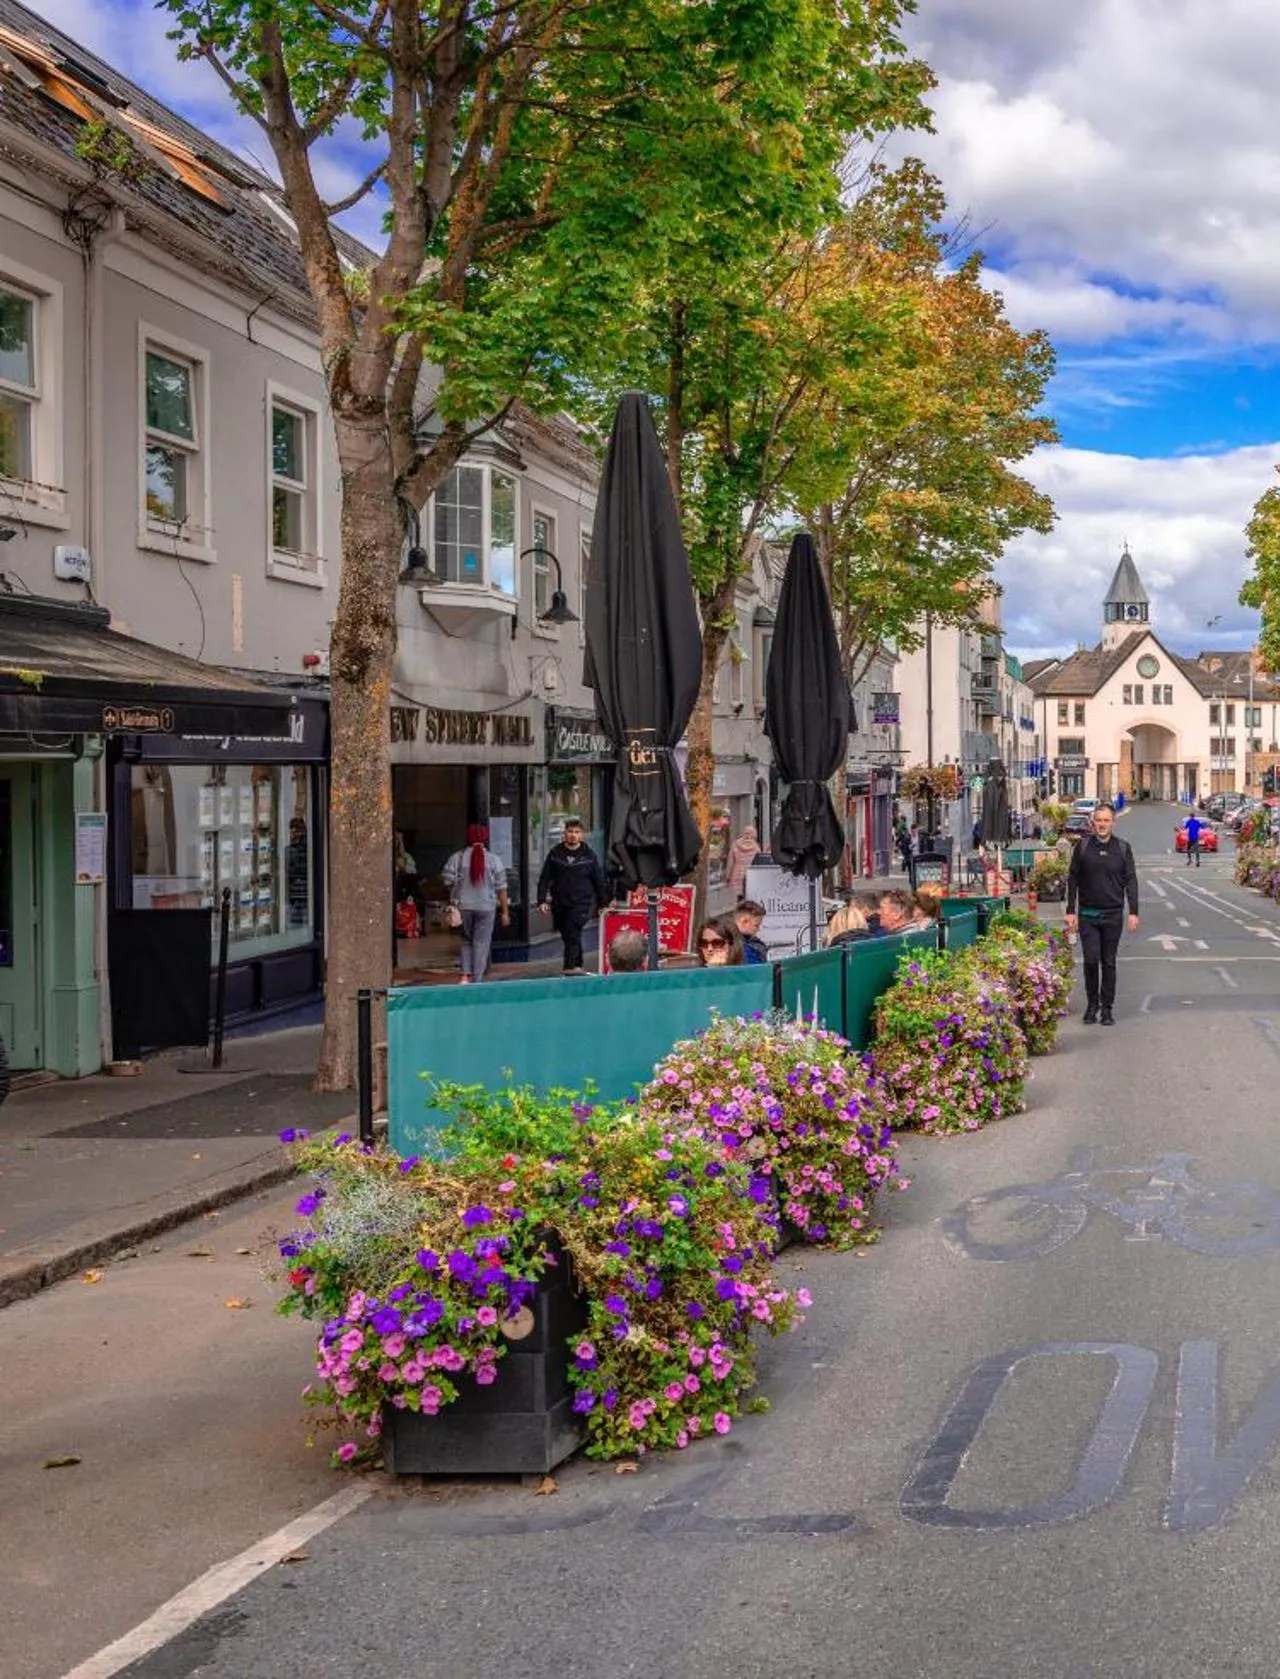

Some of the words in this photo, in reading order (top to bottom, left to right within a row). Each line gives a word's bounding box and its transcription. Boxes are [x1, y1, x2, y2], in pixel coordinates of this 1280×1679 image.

[388, 705, 421, 743] EW
[426, 708, 490, 745] STREET
[490, 714, 535, 747] MALL
